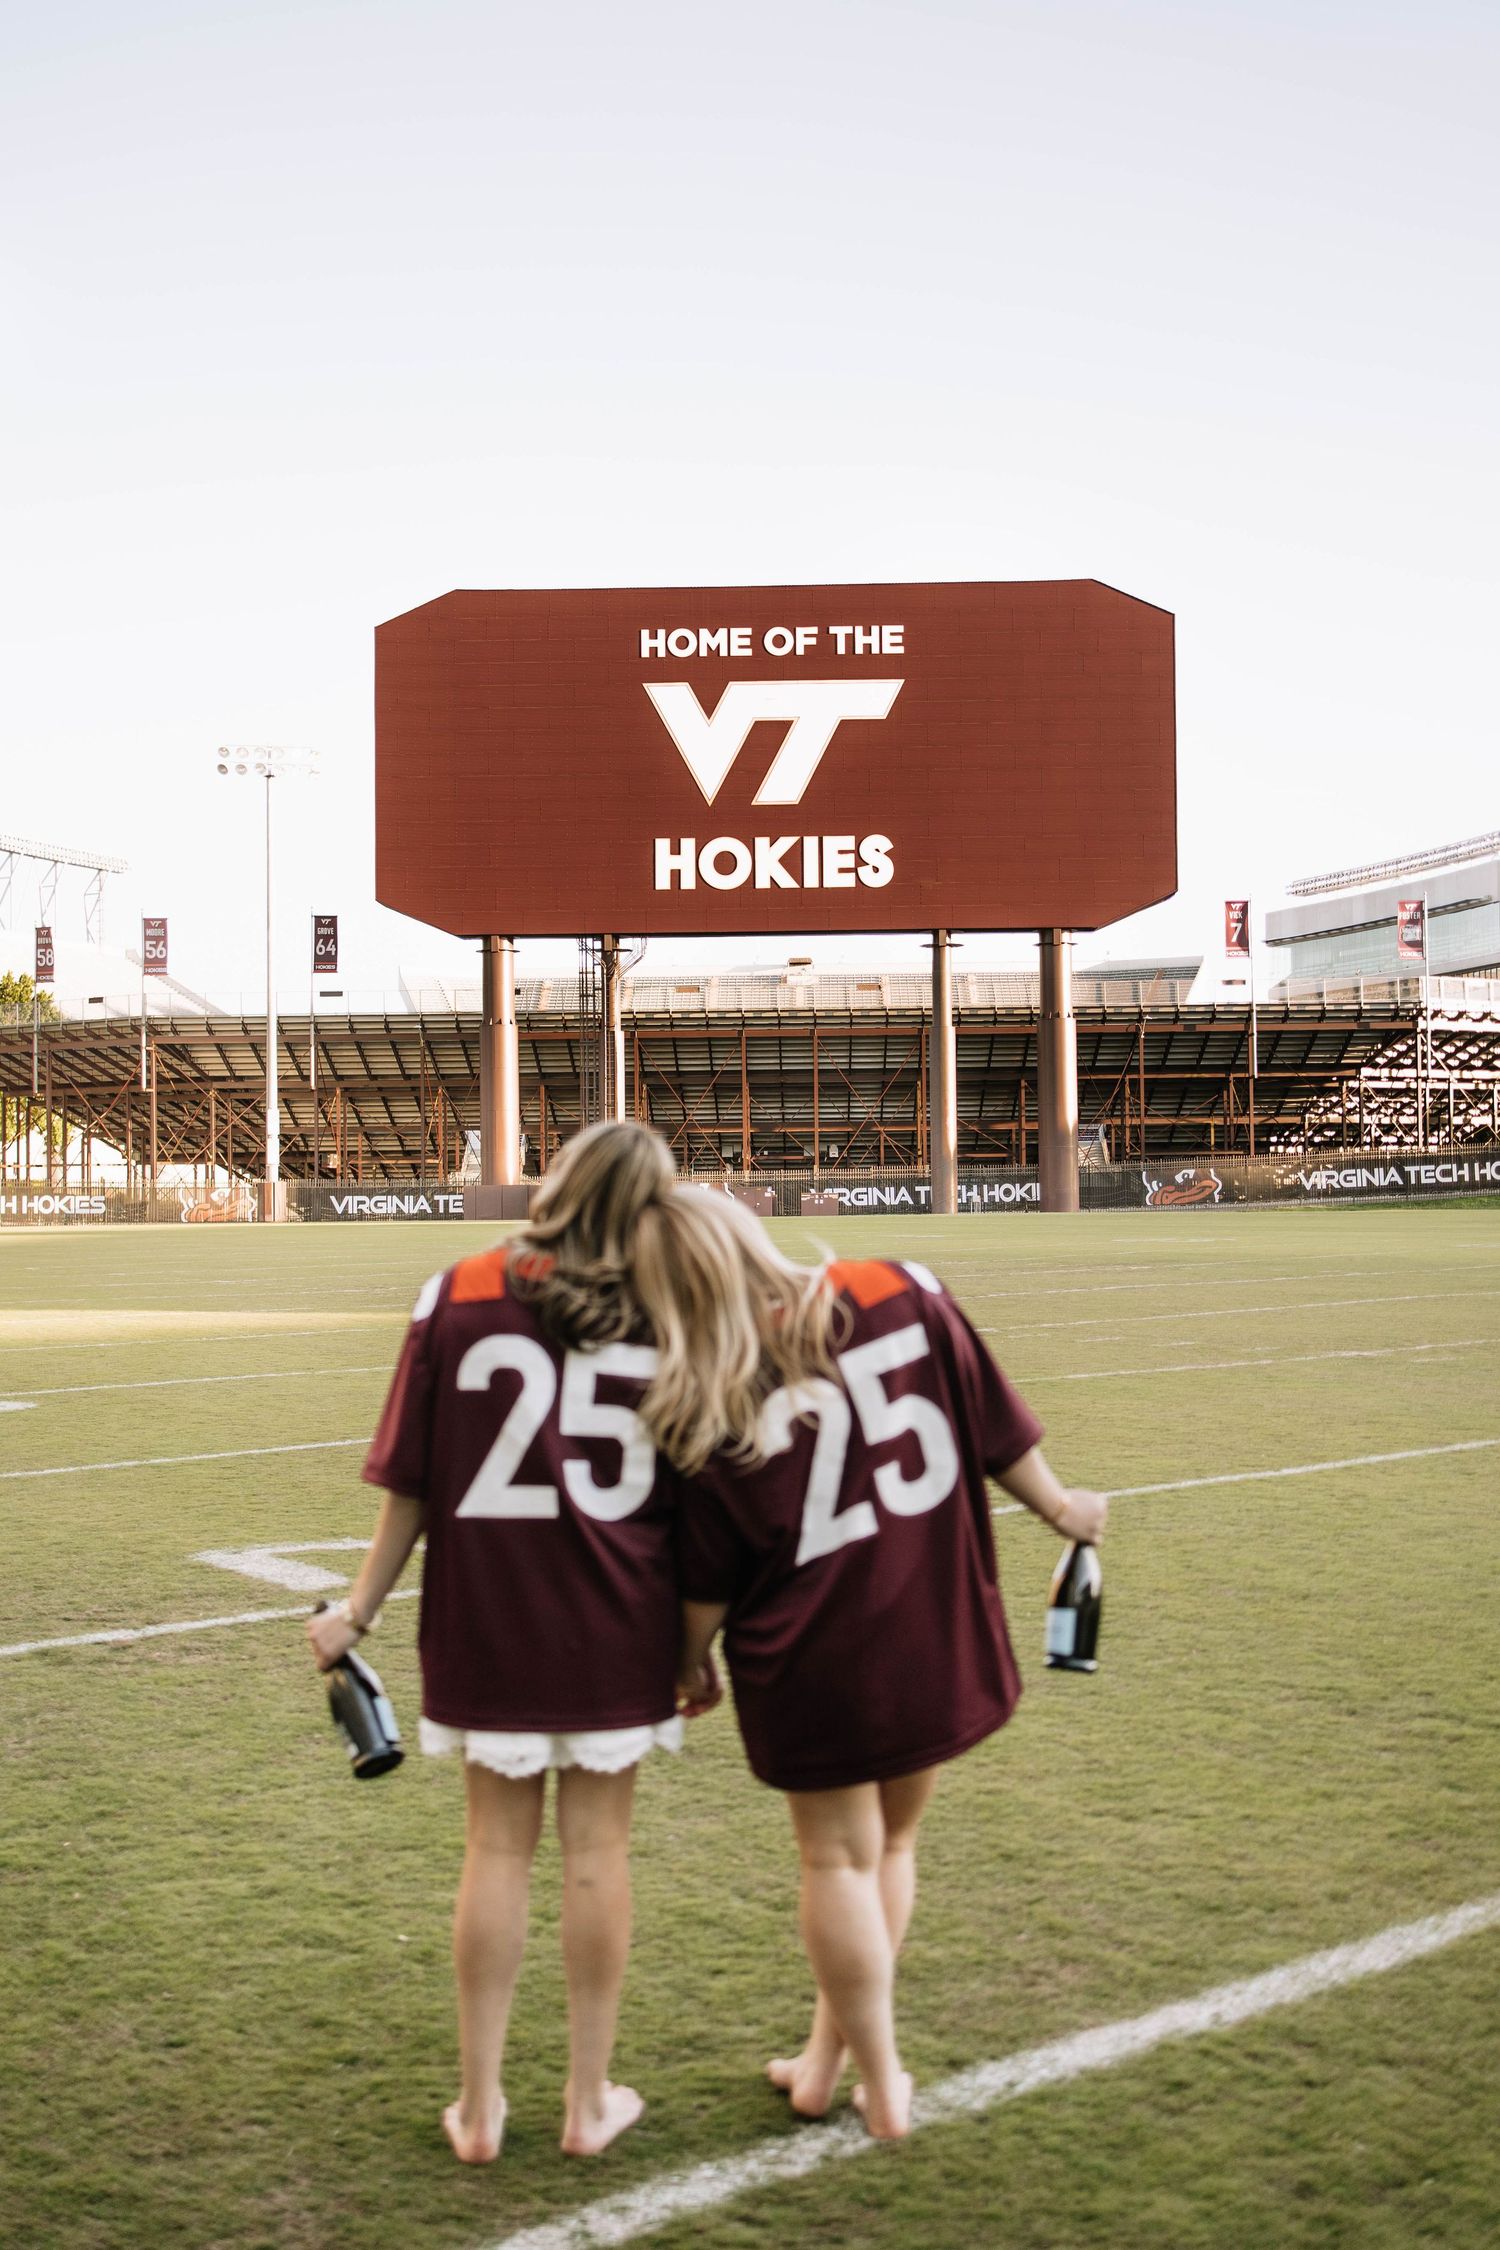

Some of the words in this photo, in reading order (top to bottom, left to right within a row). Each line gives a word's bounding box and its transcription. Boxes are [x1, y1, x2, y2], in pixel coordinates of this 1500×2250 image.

[640, 627, 753, 658] HOME
[763, 626, 819, 656] OF
[829, 624, 905, 655] THE
[641, 678, 906, 807] VT
[654, 834, 895, 890] HOKIES
[1399, 911, 1421, 919] FOSTER
[146, 928, 165, 936] MOORE
[1230, 923, 1243, 942] 7
[146, 940, 167, 958] 56
[316, 938, 337, 956] 64
[37, 948, 54, 967] 58
[1298, 1166, 1404, 1191] VIRGINIA
[1403, 1163, 1470, 1185] TECH
[22, 1195, 107, 1214] HOKIES
[329, 1194, 433, 1215] VIRGINIA
[810, 1186, 914, 1206] RGINIA
[455, 1333, 658, 1522] 25
[759, 1322, 961, 1567] 25
